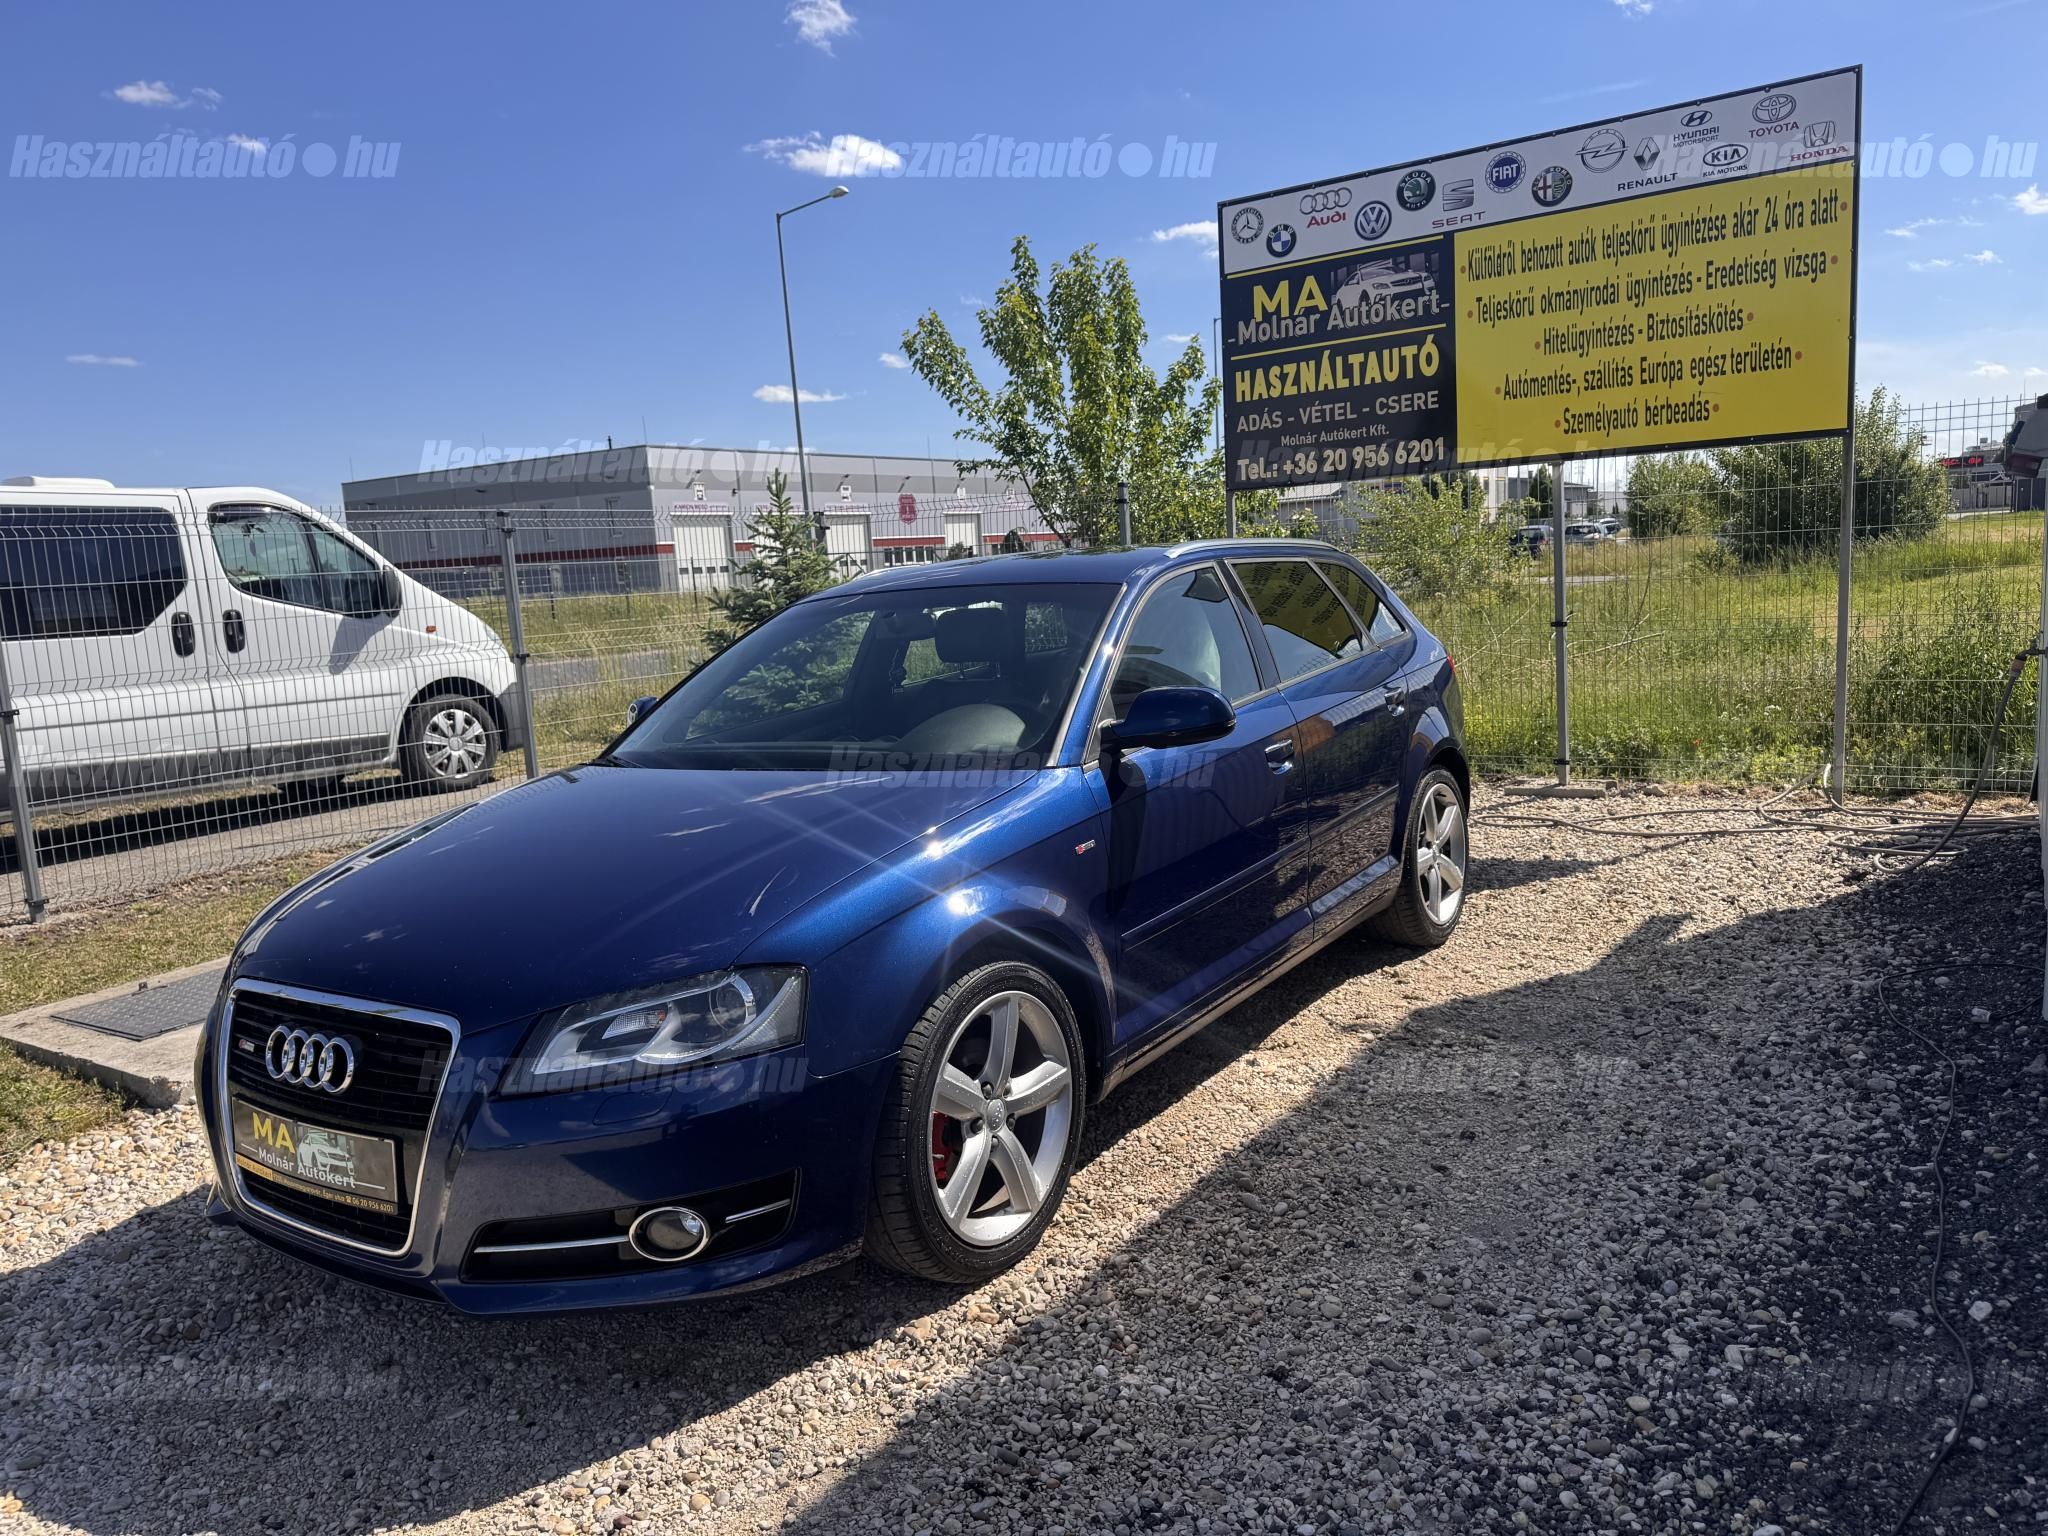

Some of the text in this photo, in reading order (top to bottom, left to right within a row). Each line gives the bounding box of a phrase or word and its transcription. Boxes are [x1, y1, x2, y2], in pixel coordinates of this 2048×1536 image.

[1672, 134, 1719, 148] MOTORSPORT
[1673, 126, 1720, 142] HYUNDAI
[1749, 121, 1800, 138] TOYOTA
[1711, 148, 1741, 163] KIA
[1790, 145, 1848, 161] HONDA
[1492, 163, 1519, 181] FIAT
[1717, 164, 1748, 175] MOTORS
[1617, 173, 1678, 191] RENAULT
[1307, 211, 1346, 228] Audi
[1432, 211, 1486, 229] SEAT
[1467, 188, 1839, 282] Külföldről behozott autók teljeskörű ügyintézése akár 24 óra alatt
[1253, 275, 1329, 322] MA
[1475, 287, 1535, 329] Teljeskörű
[1540, 273, 1620, 316] okmányirodai
[1626, 264, 1693, 308] ügyintézés
[1705, 251, 1777, 290] Eredetiség
[1784, 245, 1827, 285] vizsga
[1543, 313, 1635, 358] Hitelügyintézés
[1647, 300, 1744, 343] Biztosításkötés
[1235, 334, 1440, 403] HASZNÁLTAUTÓ
[1583, 350, 1634, 392] szállítás
[1640, 350, 1684, 392] Európa
[1690, 346, 1727, 388] egész
[1730, 337, 1793, 375] területén
[1237, 407, 1283, 433] ADÁS
[1300, 398, 1357, 425] VÉTEL
[1375, 390, 1439, 416] CSERE
[1563, 391, 1711, 438] Személyautó bérbeadás
[1281, 422, 1389, 447] Molnár Autókert Kft.
[1283, 453, 1318, 476] +36
[1323, 448, 1347, 472] 20
[1353, 443, 1389, 467] 956
[1395, 436, 1444, 464] 6201
[252, 1112, 295, 1153] MA
[258, 1149, 295, 1173] Molnár
